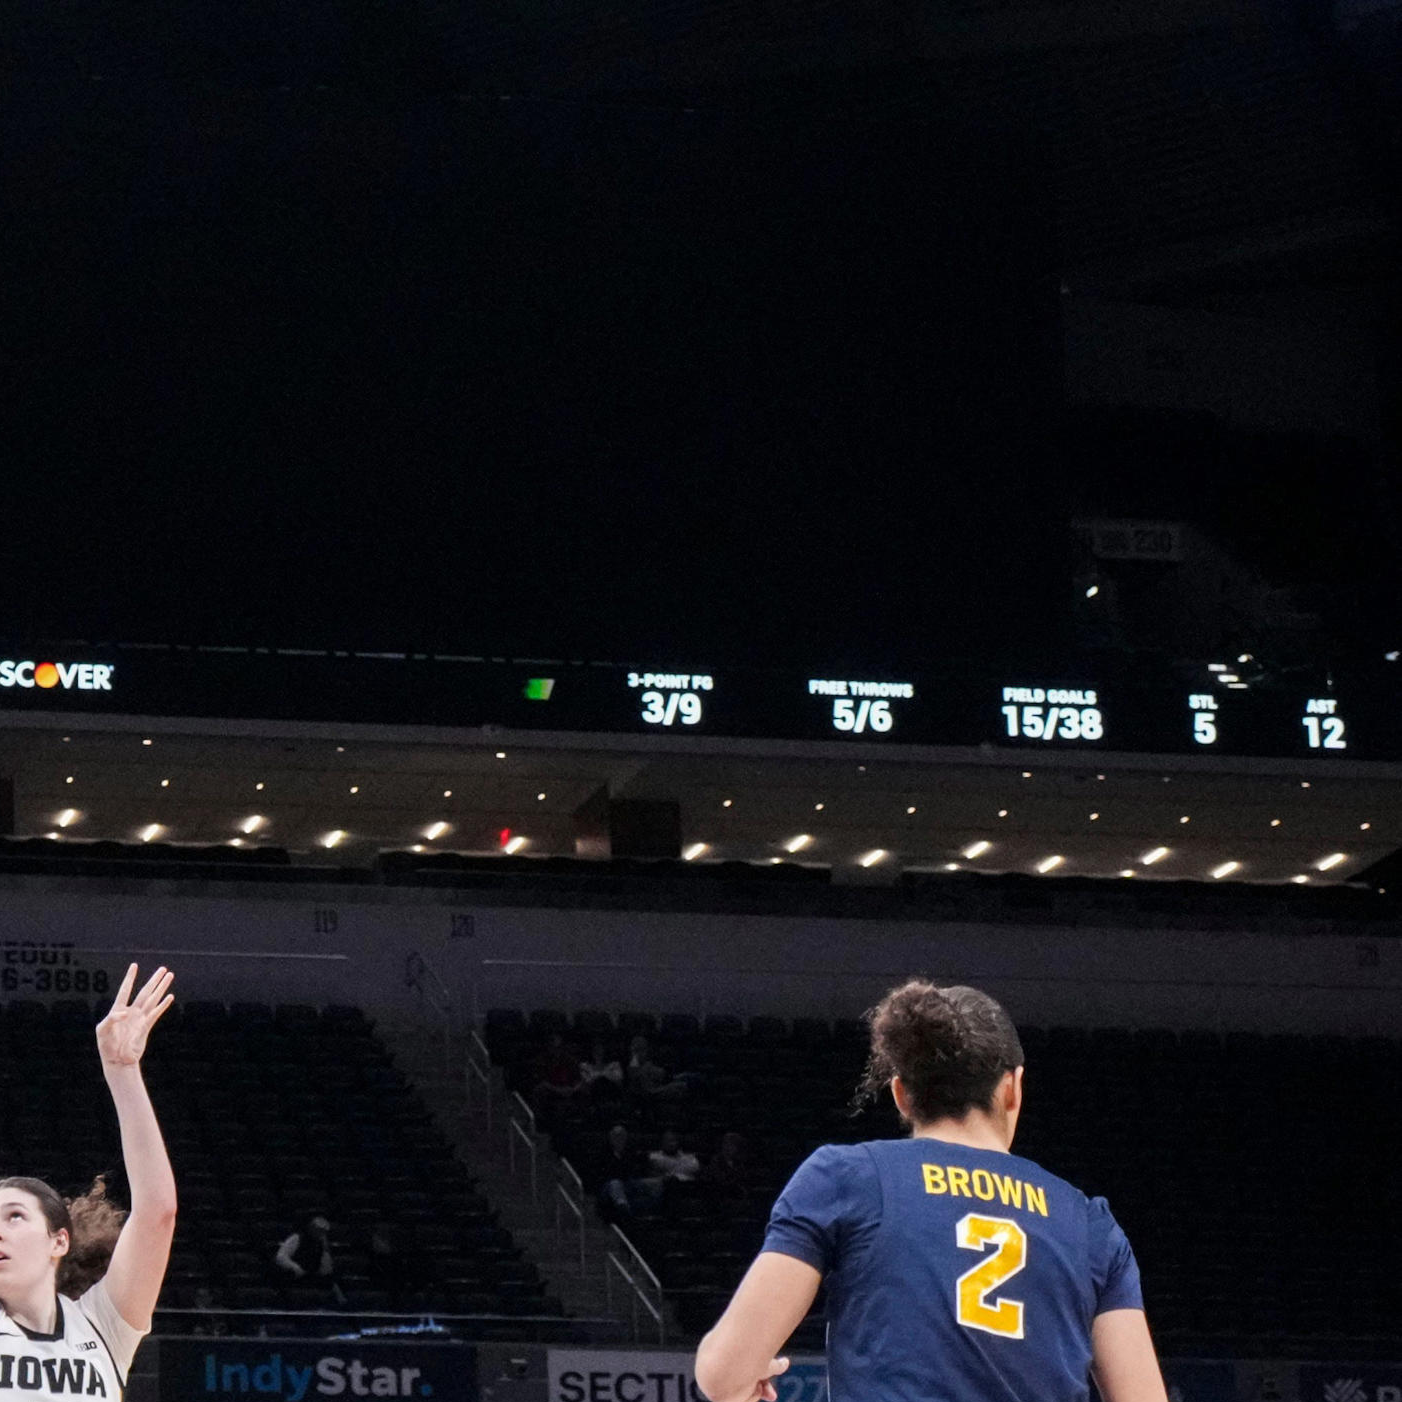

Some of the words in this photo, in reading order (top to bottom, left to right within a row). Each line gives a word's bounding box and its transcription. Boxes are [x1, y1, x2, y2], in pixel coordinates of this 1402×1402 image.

[627, 672, 690, 691] 3-POINT
[691, 675, 714, 691] FG
[808, 679, 848, 698] FREE
[849, 681, 914, 703] THROWS
[1002, 687, 1045, 705] FIELD
[1047, 689, 1097, 708] GOALS
[641, 691, 702, 726] 3/9
[833, 699, 893, 734] 5/6
[1189, 694, 1219, 714] STL
[1306, 699, 1337, 714] AST
[1002, 705, 1104, 741] 15/38
[1194, 712, 1217, 744] 5
[1302, 716, 1347, 749] 12
[923, 1163, 1049, 1219] BROWN
[955, 1212, 1028, 1340] 2
